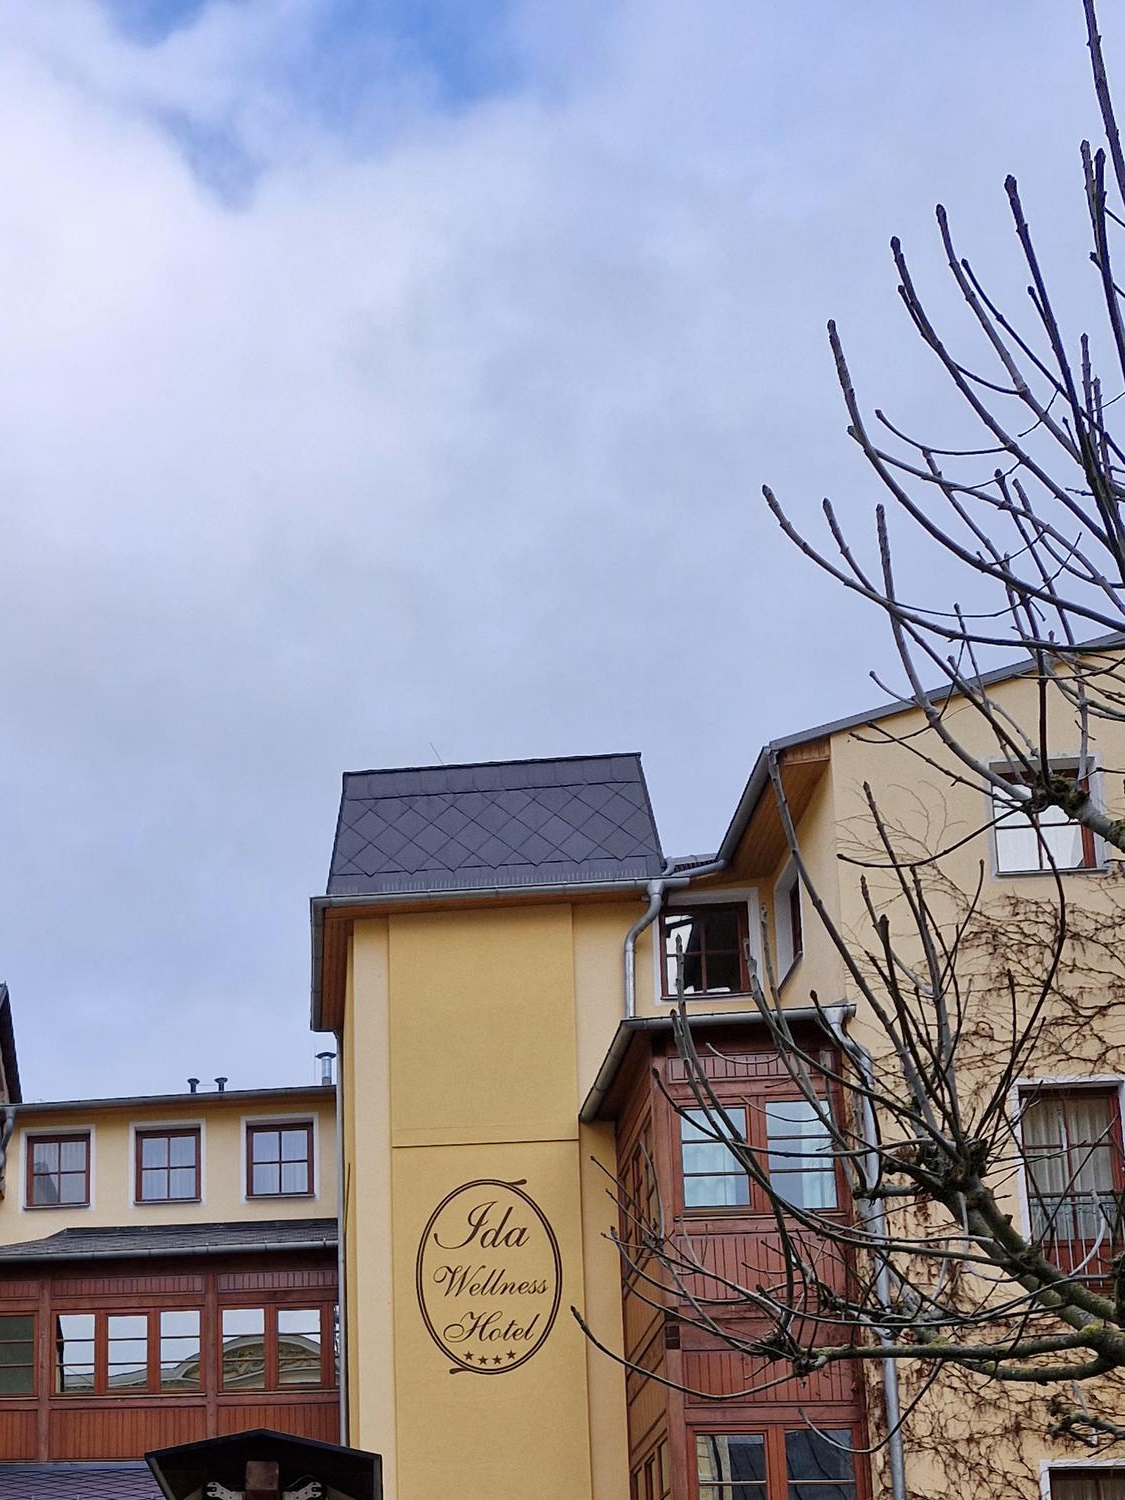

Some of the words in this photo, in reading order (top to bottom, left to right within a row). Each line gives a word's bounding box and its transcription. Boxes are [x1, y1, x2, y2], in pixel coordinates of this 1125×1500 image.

[433, 1200, 530, 1250] Ida
[433, 1264, 549, 1297] Wellness
[443, 1311, 540, 1343] Hotel
